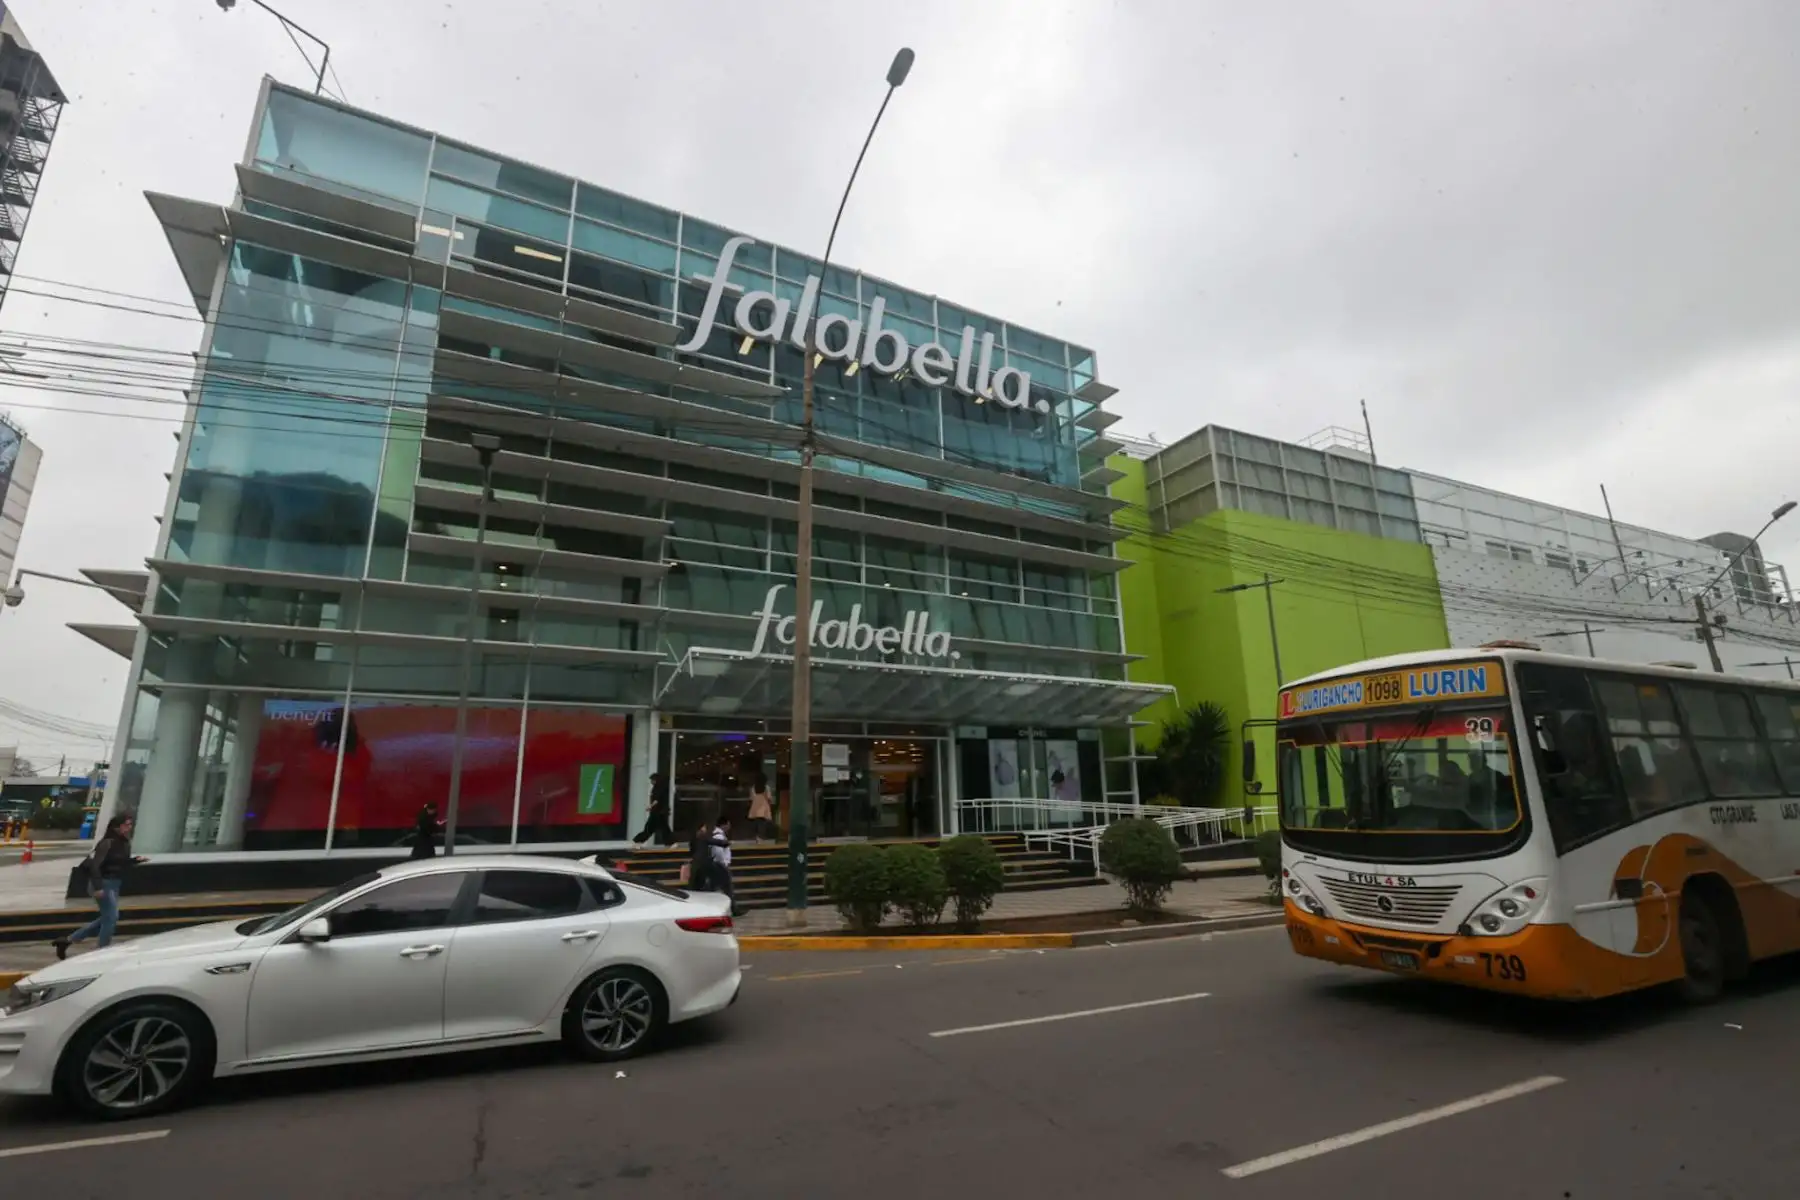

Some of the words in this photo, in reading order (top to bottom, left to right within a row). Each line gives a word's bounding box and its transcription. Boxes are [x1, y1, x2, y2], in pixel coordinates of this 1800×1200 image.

[1367, 680, 1400, 702] 1098
[1409, 667, 1487, 698] LURIN
[1465, 717, 1494, 743] 39
[1348, 872, 1381, 885] ETUL
[1385, 876, 1394, 886] 4
[1397, 876, 1417, 886] SA
[1479, 952, 1526, 982] 739
